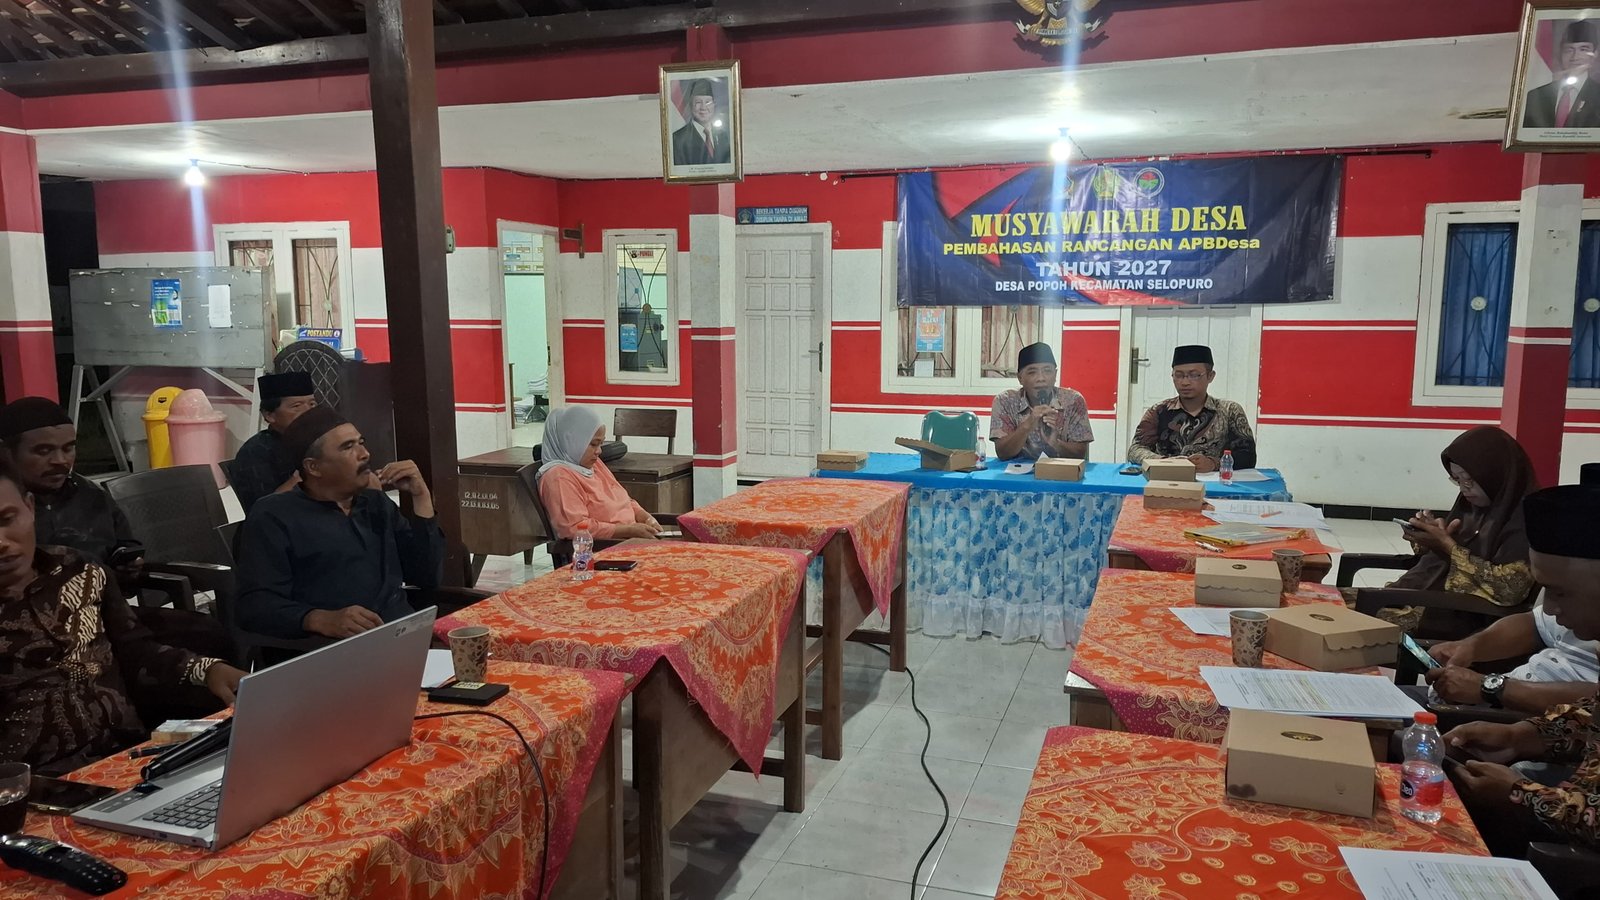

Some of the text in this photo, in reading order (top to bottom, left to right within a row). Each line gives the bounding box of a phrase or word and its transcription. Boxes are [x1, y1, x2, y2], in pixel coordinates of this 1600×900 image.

[970, 205, 1247, 238] MUSYAWARAH DESA
[943, 236, 1260, 255] PEMBAHASAN RANCANGAN APBDesa
[1035, 259, 1172, 277] TAHUN 2027
[995, 278, 1213, 292] DESA POPOH KECAMATAN SELOPURO
